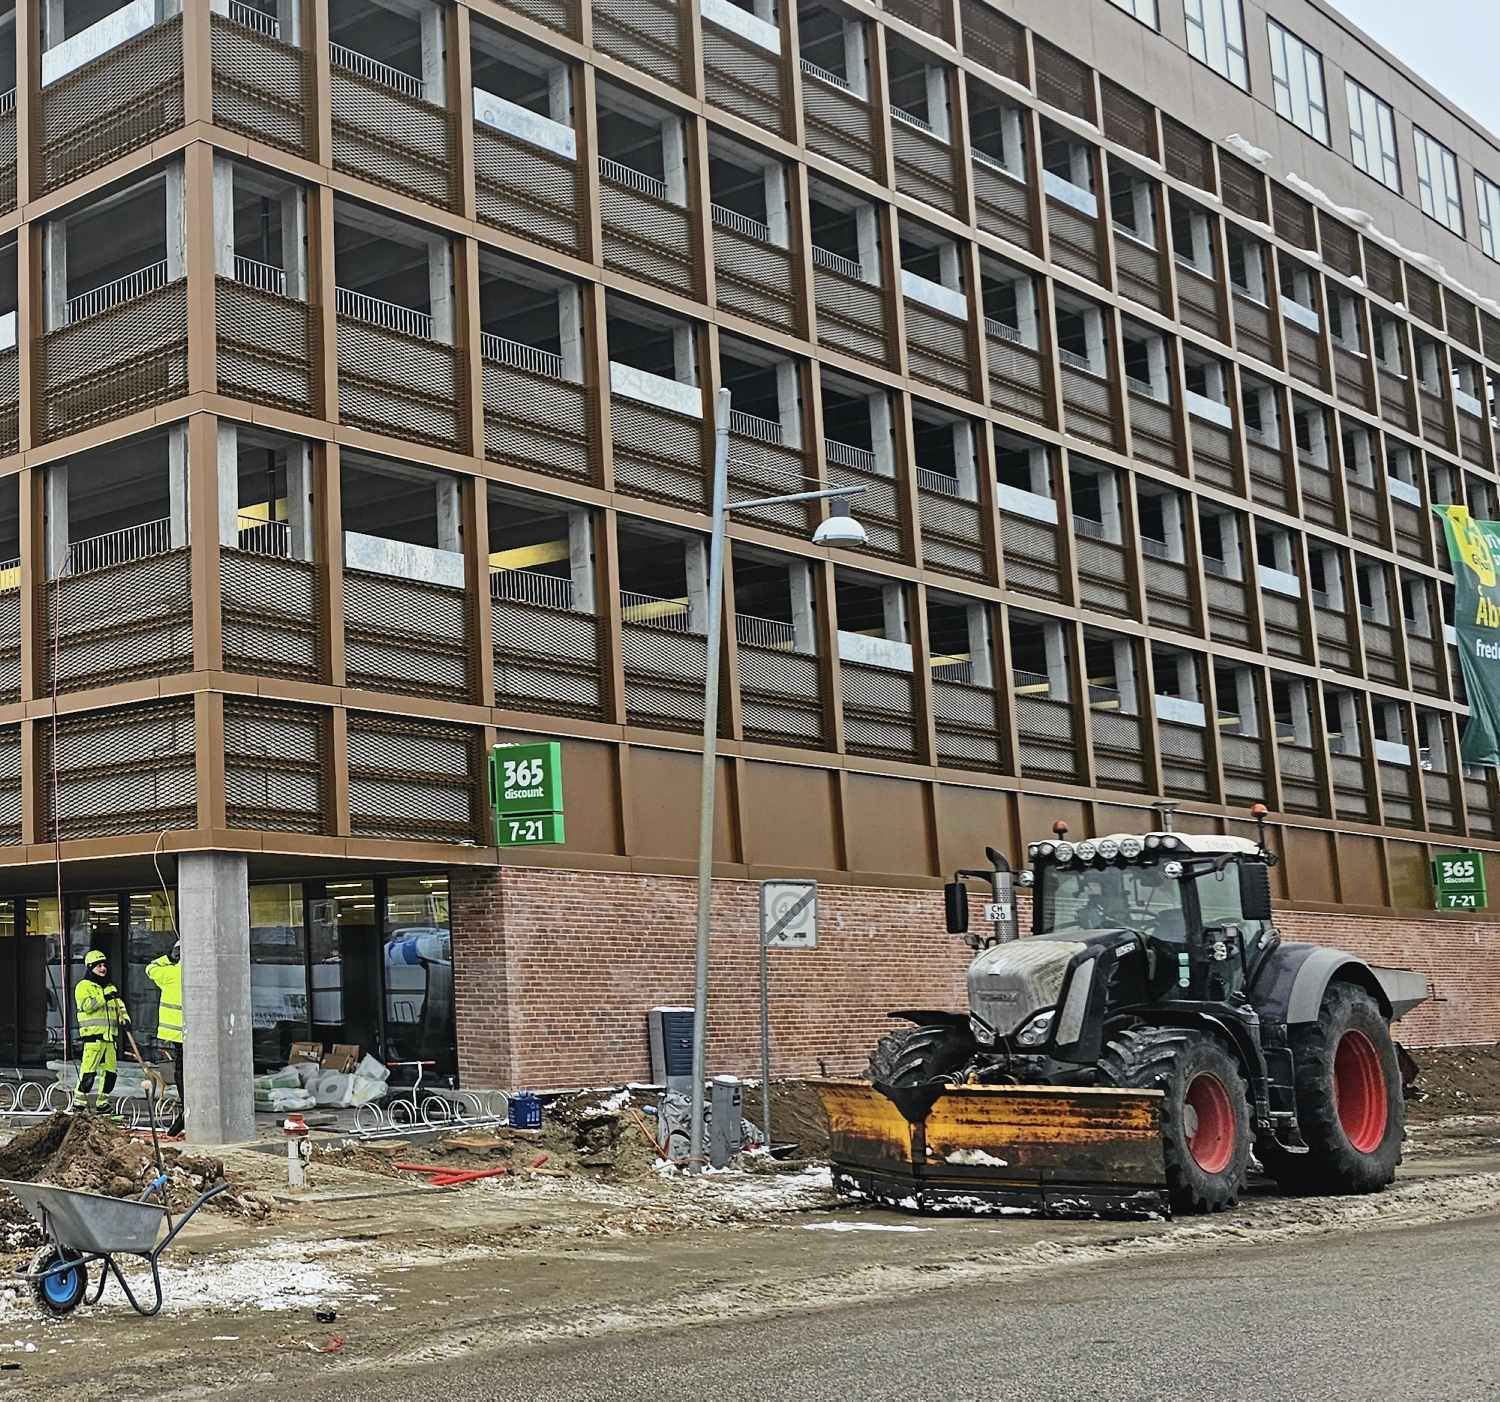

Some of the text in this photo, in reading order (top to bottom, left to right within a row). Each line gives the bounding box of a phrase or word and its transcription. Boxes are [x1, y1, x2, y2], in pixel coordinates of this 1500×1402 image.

[1476, 584, 1500, 628] Åb
[503, 758, 544, 788] 365
[504, 786, 544, 800] discount
[508, 820, 543, 841] 7-21
[1442, 860, 1475, 877] 365
[1443, 876, 1475, 884] discount
[1448, 895, 1476, 907] 7-21
[990, 912, 1006, 920] 820
